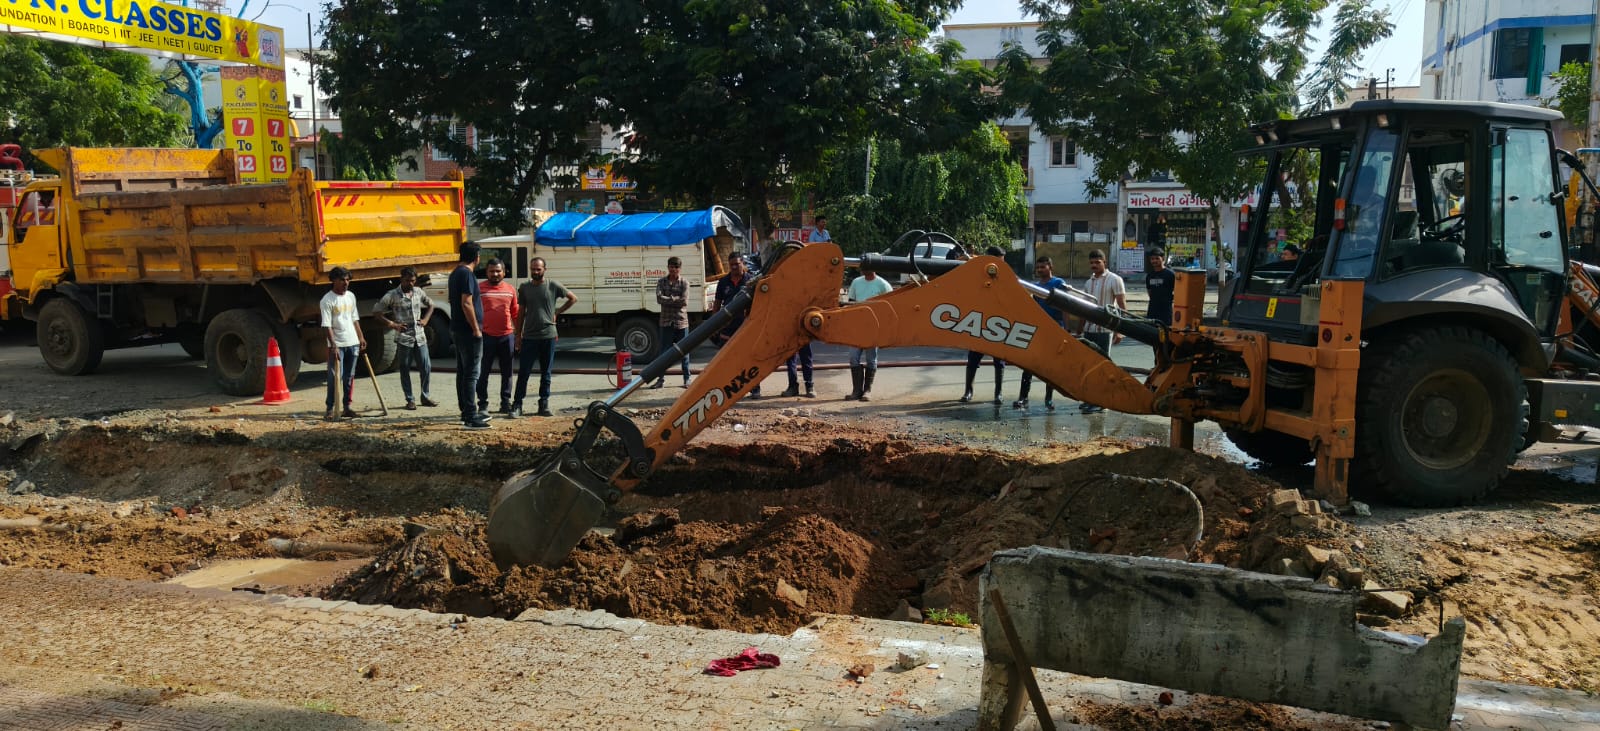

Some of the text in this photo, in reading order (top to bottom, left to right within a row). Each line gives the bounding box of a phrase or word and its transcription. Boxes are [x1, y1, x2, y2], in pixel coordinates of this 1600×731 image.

[78, 0, 222, 42] CLASSES
[0, 7, 57, 27] UNDATION
[68, 19, 110, 35] BOARDS
[120, 30, 132, 40] IIT
[138, 33, 155, 44] JEE
[163, 37, 186, 49] NEET
[193, 42, 224, 55] GUJCET
[237, 119, 248, 135] 7
[271, 120, 280, 136] 7
[236, 140, 252, 151] To
[271, 140, 283, 152] To
[239, 156, 255, 171] 12
[271, 157, 286, 172] 12
[551, 165, 579, 177] CAKE
[1130, 193, 1175, 207] માતેશ્વરી
[930, 303, 1038, 349] CASE
[672, 366, 759, 437] 770 NXe
